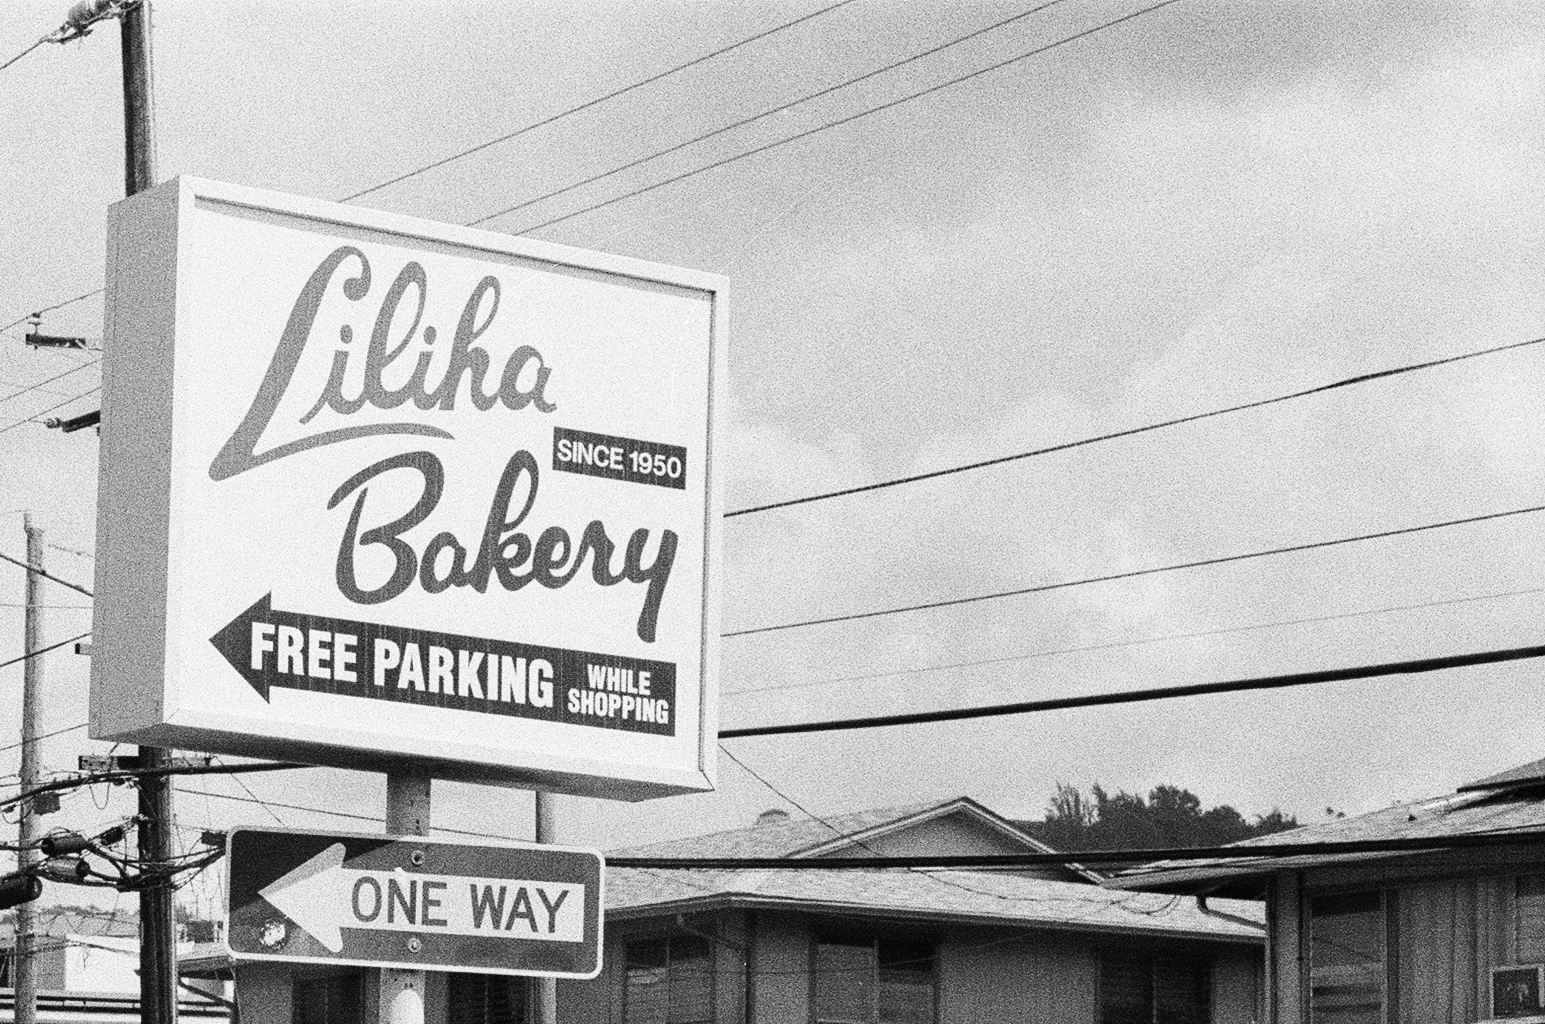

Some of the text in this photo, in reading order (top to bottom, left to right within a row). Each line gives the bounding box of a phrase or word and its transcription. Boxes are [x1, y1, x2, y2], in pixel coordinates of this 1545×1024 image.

[208, 245, 557, 482] Liliha
[557, 438, 682, 479] SINCE 1950
[326, 449, 679, 644] Bakery
[250, 621, 554, 709] FREE PARKING
[587, 663, 651, 697] WHILE
[567, 689, 670, 725] SHOPPING
[352, 875, 570, 934] ONE WAY
